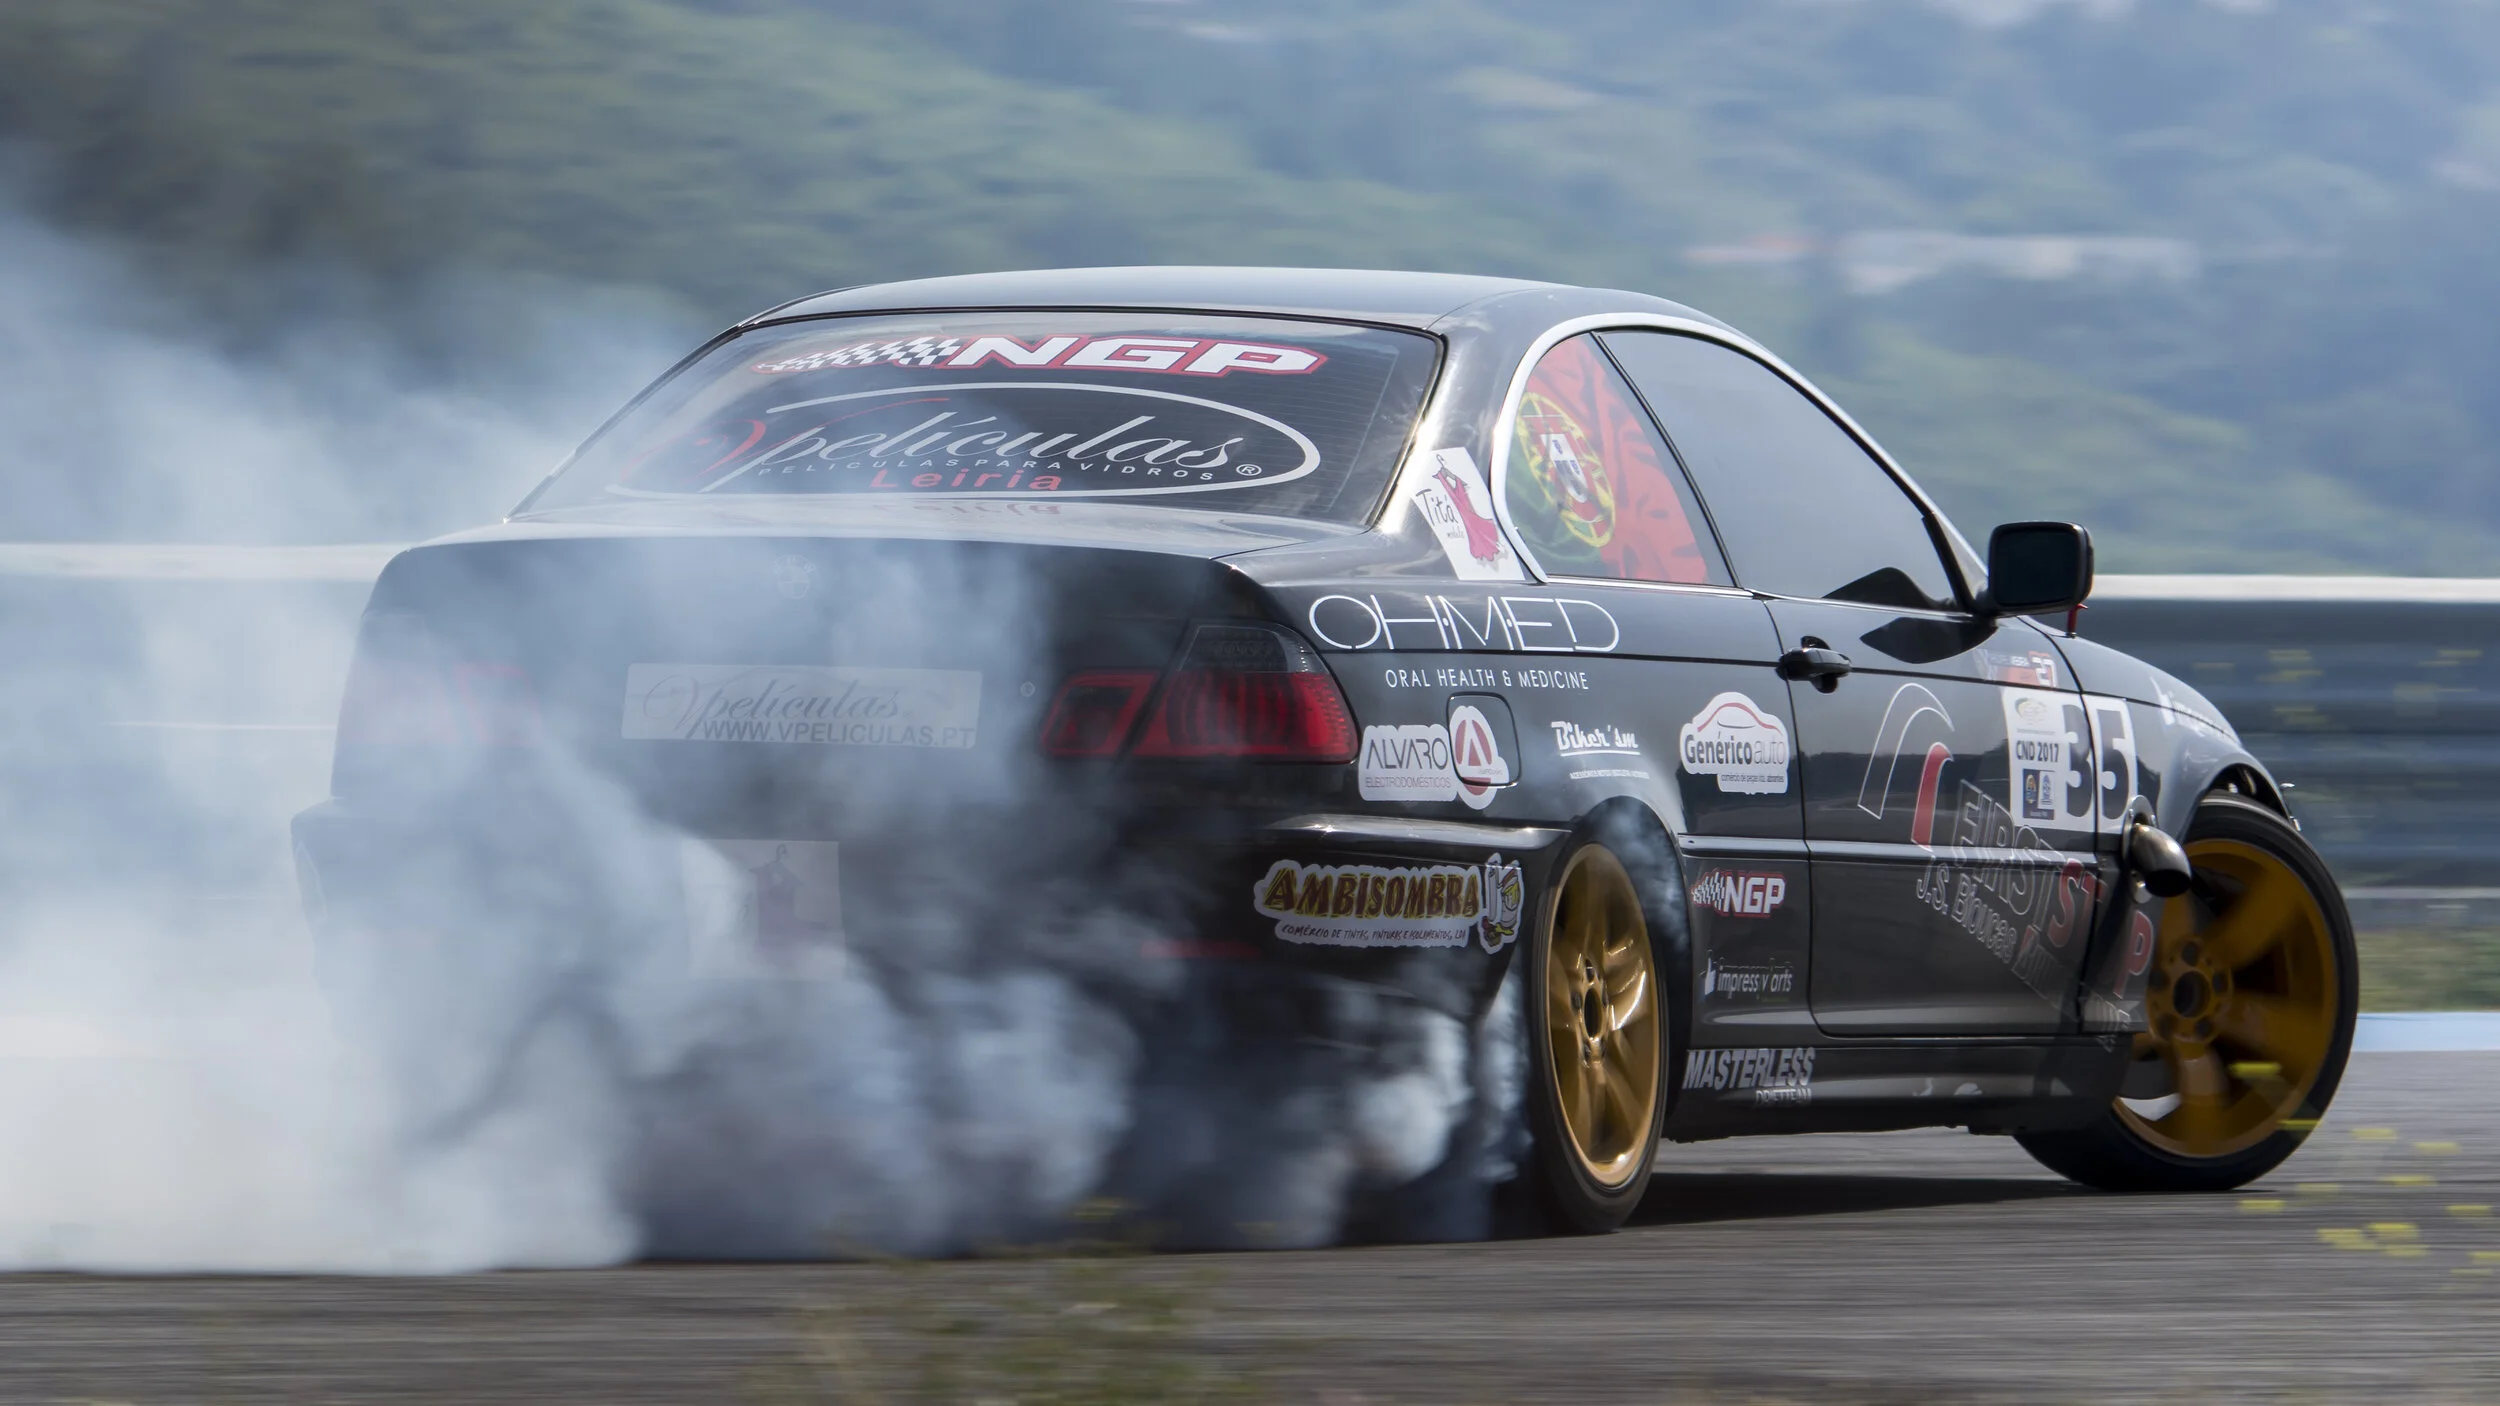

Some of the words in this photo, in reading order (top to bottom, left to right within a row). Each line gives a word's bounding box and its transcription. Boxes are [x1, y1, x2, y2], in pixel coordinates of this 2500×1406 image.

[943, 335, 1328, 377] NGP
[757, 458, 960, 477] PELICULAS
[975, 458, 1062, 470] PARA
[1080, 463, 1213, 481] VIDROS
[869, 468, 1062, 491] Leiria
[1385, 669, 1431, 688] ORAL
[1437, 669, 1496, 688] HEALTH
[1503, 669, 1512, 686] &
[1518, 669, 1590, 690] MEDICINE
[702, 718, 978, 748] WWW.VPELICULAS.PT
[2016, 740, 2035, 760] CND
[2037, 742, 2060, 763] 2017
[1723, 874, 1786, 914] NGP
[1331, 929, 1342, 938] DE
[1682, 1047, 1817, 1090] MASTERLESS
